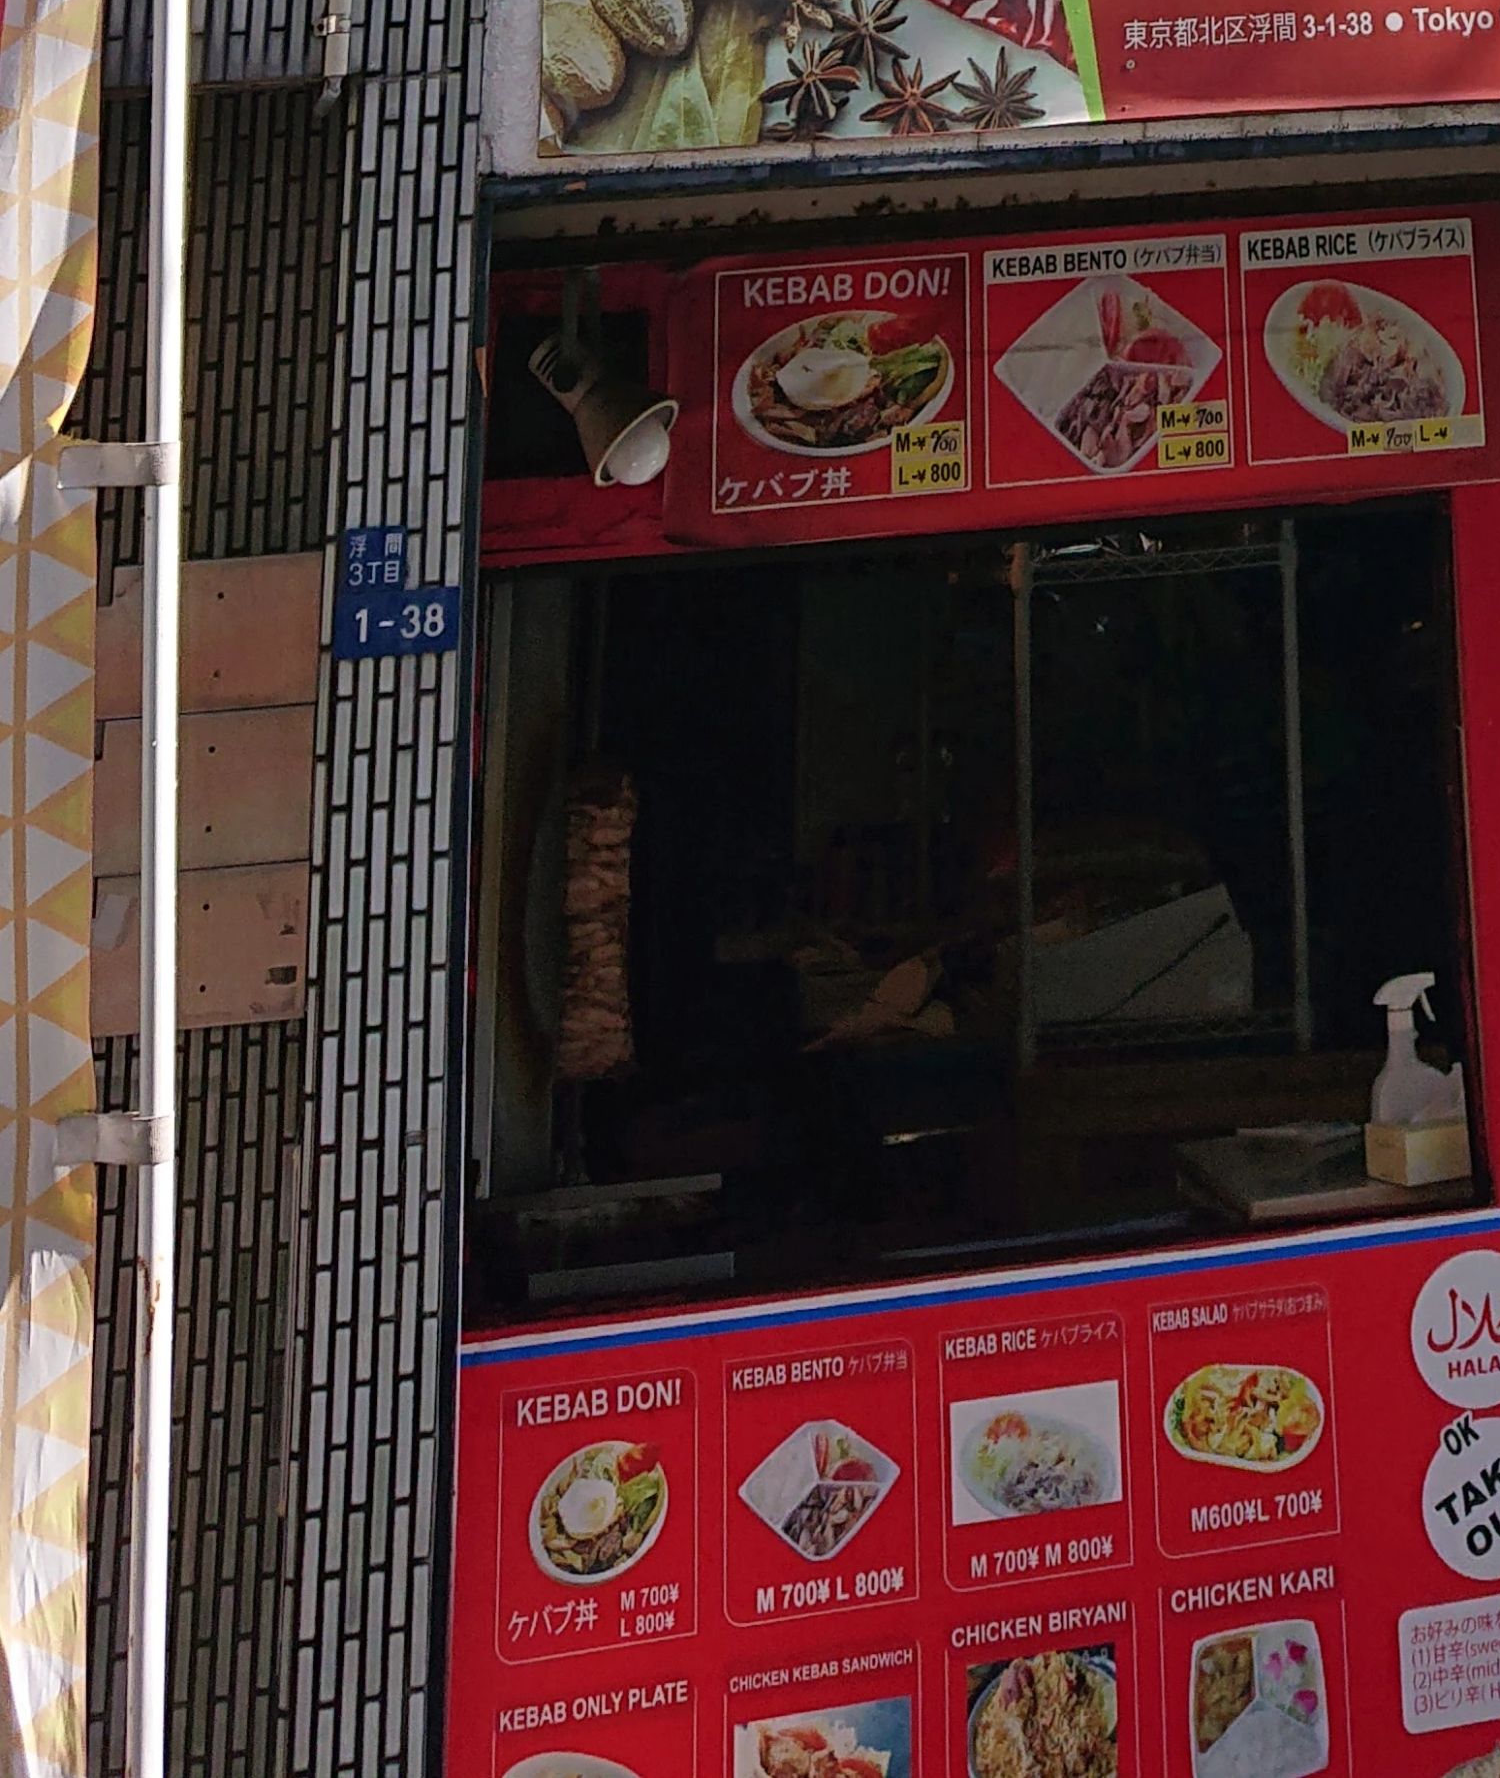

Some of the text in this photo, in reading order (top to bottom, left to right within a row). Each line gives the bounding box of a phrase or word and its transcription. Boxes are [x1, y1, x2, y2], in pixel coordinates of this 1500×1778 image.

[1124, 13, 1297, 51] 東京都北区浮間
[1302, 11, 1373, 40] 3-1-38
[1412, 6, 1494, 37] Tokyo
[992, 254, 1058, 278] KEBAB
[1063, 249, 1127, 272] BENTO
[1248, 236, 1310, 262] KEBAB
[1316, 233, 1358, 257] RICE
[743, 267, 950, 308] KEBAB DON!
[718, 467, 852, 506] ケバブ丼
[349, 560, 400, 586] 3丁目
[355, 602, 445, 643] 1-38
[1152, 1307, 1190, 1333] KEBAB
[1192, 1303, 1228, 1327] SALAD
[945, 1333, 997, 1360] KEBAB
[1001, 1327, 1037, 1353] RICE
[732, 1364, 787, 1391] KEBAB
[791, 1356, 845, 1383] BENTO
[517, 1378, 681, 1427] KEBAB DON!
[1443, 1415, 1480, 1456] OK
[971, 1534, 1113, 1578] M 700¥ M 800¥
[621, 1583, 680, 1611] M 700¥
[756, 1566, 904, 1614] M 700¥ L 800¥
[1171, 1565, 1335, 1613] CHICKEN KARI
[508, 1598, 598, 1642] ケバブ丼
[621, 1610, 676, 1637] L 800¥
[952, 1601, 1127, 1647] CHICKEN BIRYANI
[729, 1648, 913, 1693] CHICKEN KEBAB SANDWICH
[500, 1680, 688, 1733] KEBAB ONLY PLATE
